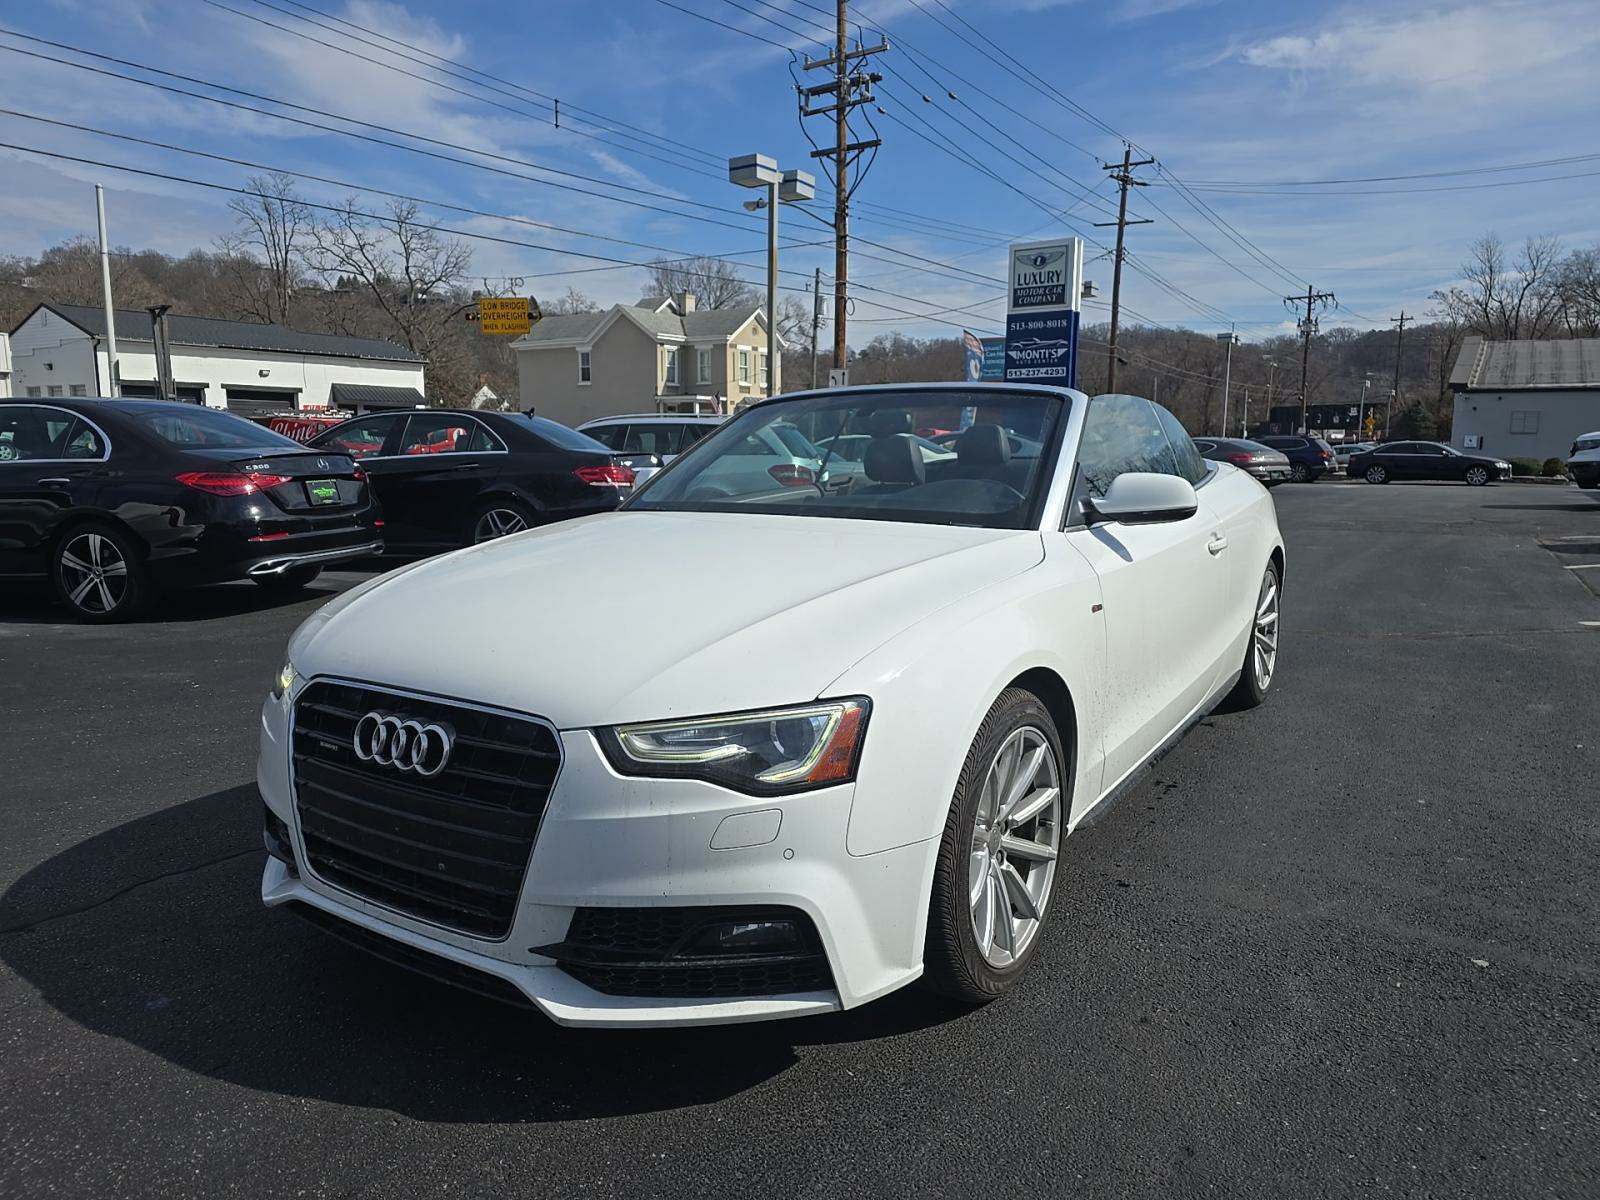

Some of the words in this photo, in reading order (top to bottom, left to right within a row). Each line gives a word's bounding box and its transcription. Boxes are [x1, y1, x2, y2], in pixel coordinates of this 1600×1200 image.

[1017, 270, 1062, 287] LUXURY
[1017, 287, 1044, 296] MOTOR
[1045, 286, 1062, 294] CAR
[1018, 295, 1057, 304] COMPANY
[483, 302, 497, 310] LOW
[500, 301, 526, 310] BRIDGE
[483, 312, 526, 320] OVERHEIGHT
[499, 322, 528, 330] FLASHING
[1010, 319, 1067, 331] 513-800-8018
[1016, 348, 1057, 359] MONTI'S
[1008, 368, 1065, 377] 513-237-4293
